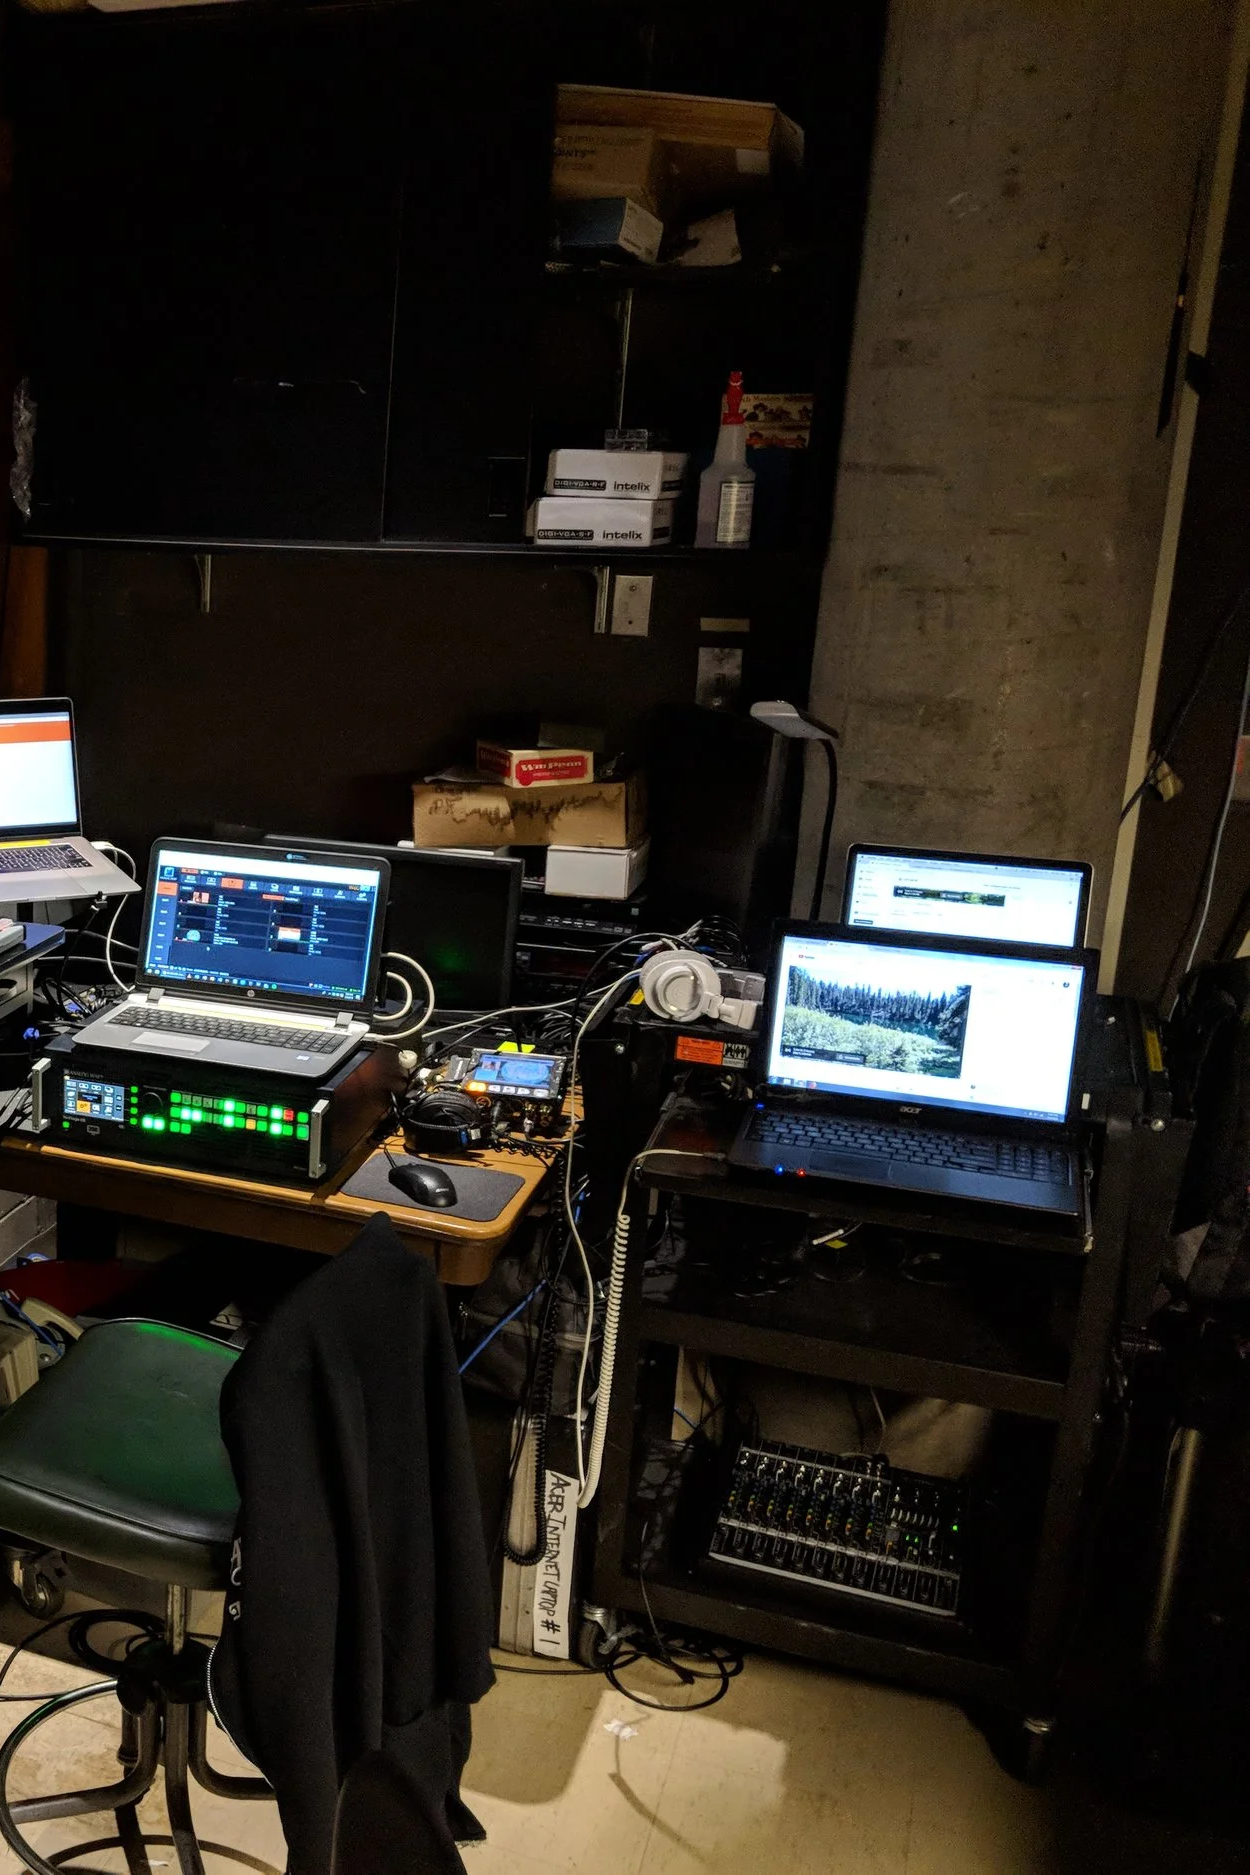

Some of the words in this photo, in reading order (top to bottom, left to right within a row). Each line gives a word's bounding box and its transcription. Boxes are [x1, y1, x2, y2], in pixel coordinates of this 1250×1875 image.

[613, 481, 650, 491] intelix
[602, 530, 642, 540] intelix
[550, 1473, 571, 1513] ACER
[544, 1514, 567, 1582] INTERNET
